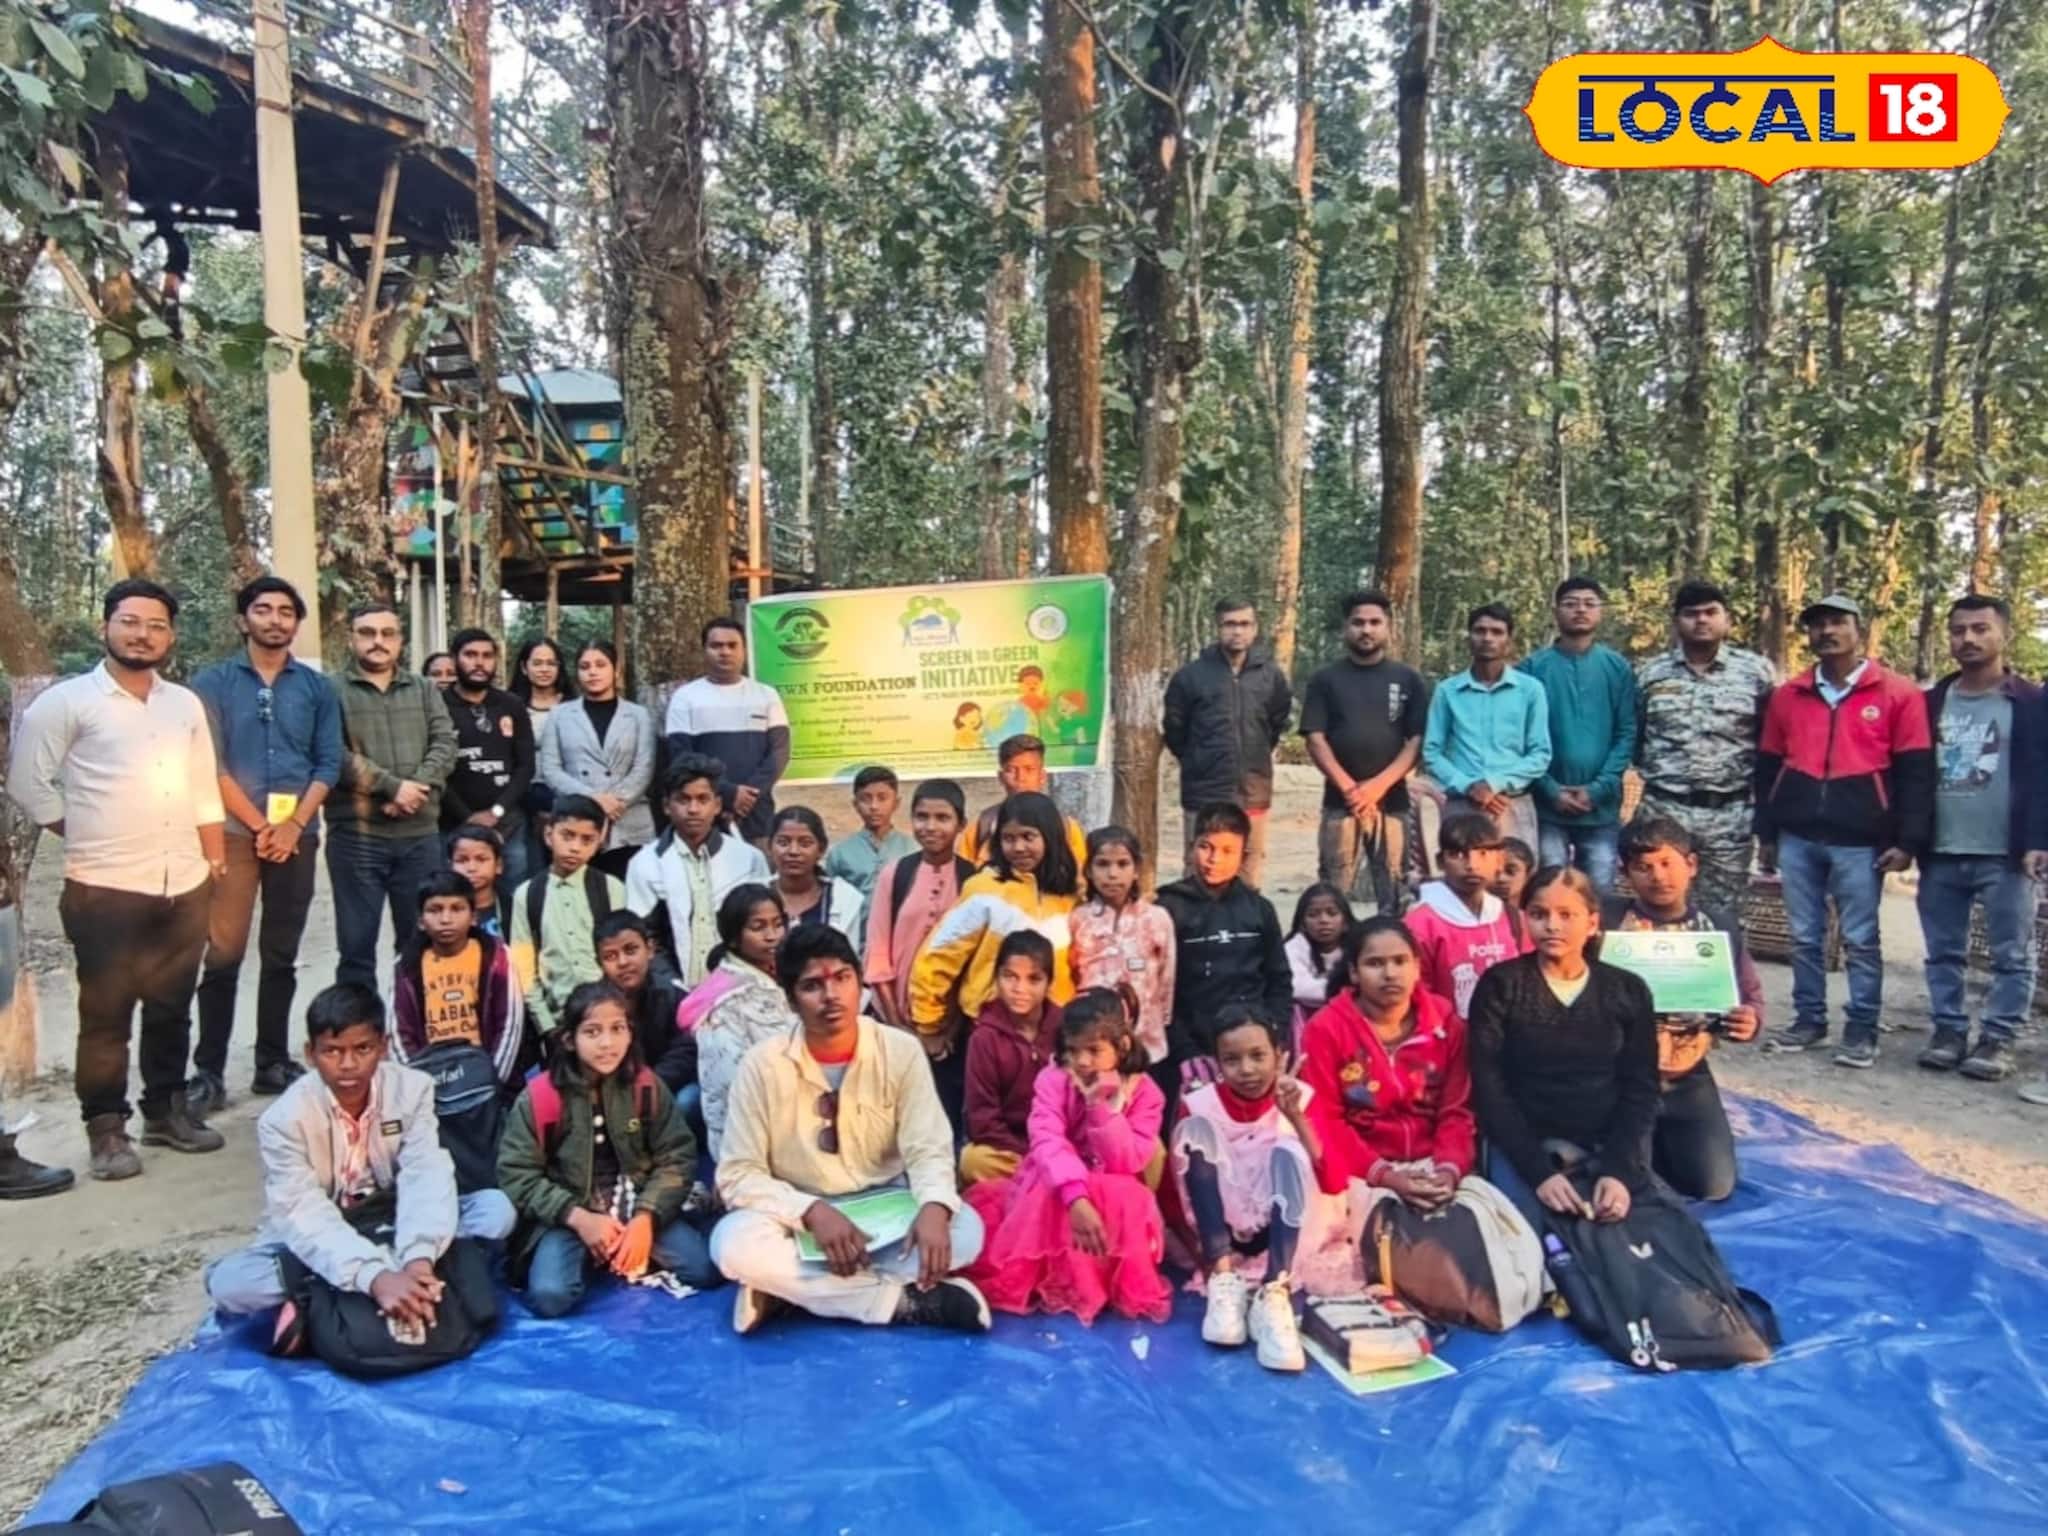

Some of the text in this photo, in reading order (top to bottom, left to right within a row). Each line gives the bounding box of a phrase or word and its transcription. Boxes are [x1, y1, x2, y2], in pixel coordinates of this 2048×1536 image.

[920, 649, 973, 667] SCREEN
[992, 645, 1039, 663] GREEN
[812, 677, 917, 695] FOUNDATION
[921, 664, 1019, 689] INITIATIVE
